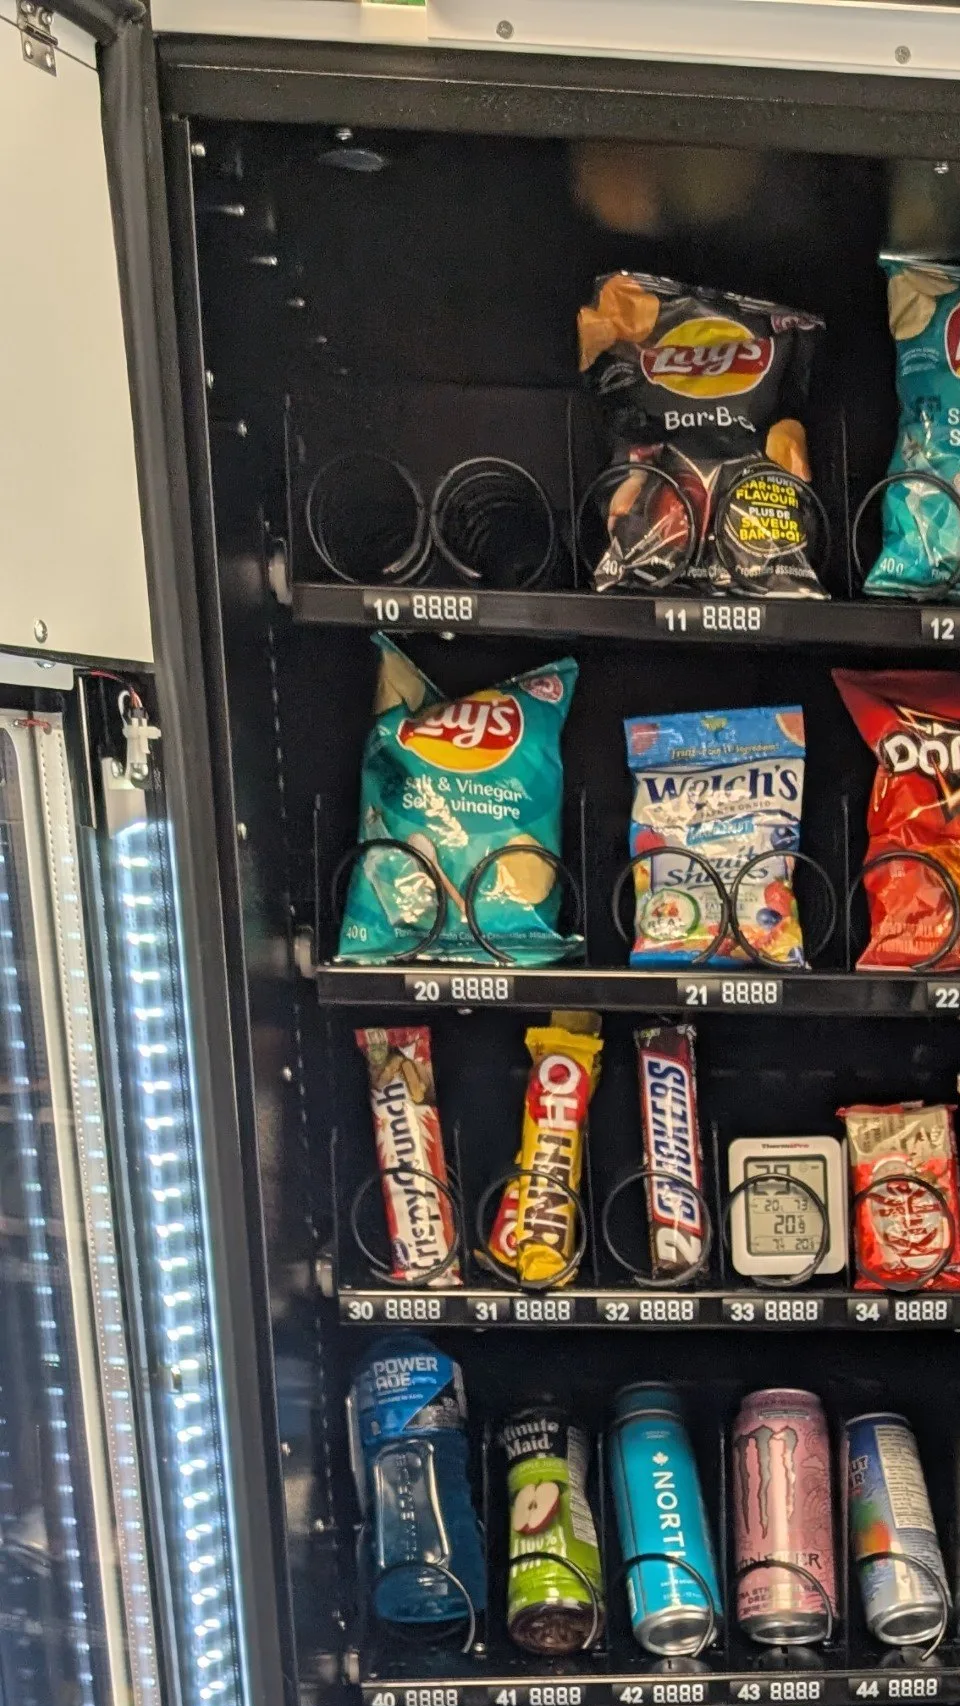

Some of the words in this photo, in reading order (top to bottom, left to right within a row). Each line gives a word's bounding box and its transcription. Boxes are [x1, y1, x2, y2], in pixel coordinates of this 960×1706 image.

[651, 341, 762, 376] Lay's
[749, 506, 775, 518] PLUS
[776, 510, 791, 521] DE
[741, 516, 799, 531] SAVEUR
[373, 599, 399, 621] 10
[664, 609, 687, 632] 11
[930, 617, 955, 640] 12
[412, 700, 515, 748] ay's
[438, 777, 451, 793] &
[455, 777, 525, 803] Vinegar
[451, 796, 520, 820] vinaigre
[414, 981, 440, 1001] 20
[686, 985, 708, 1005] 21
[935, 988, 960, 1007] 22
[537, 1055, 583, 1131] OH
[523, 1132, 573, 1250] HENR
[350, 1301, 373, 1320] 30
[477, 1303, 498, 1321] 31
[605, 1303, 630, 1321] 32
[731, 1303, 754, 1320] 33
[855, 1303, 880, 1320] 34
[374, 1356, 438, 1377] POWER
[496, 1690, 517, 1706] 41
[619, 1687, 643, 1704] 42
[737, 1683, 760, 1701] 43
[856, 1681, 880, 1698] 44
